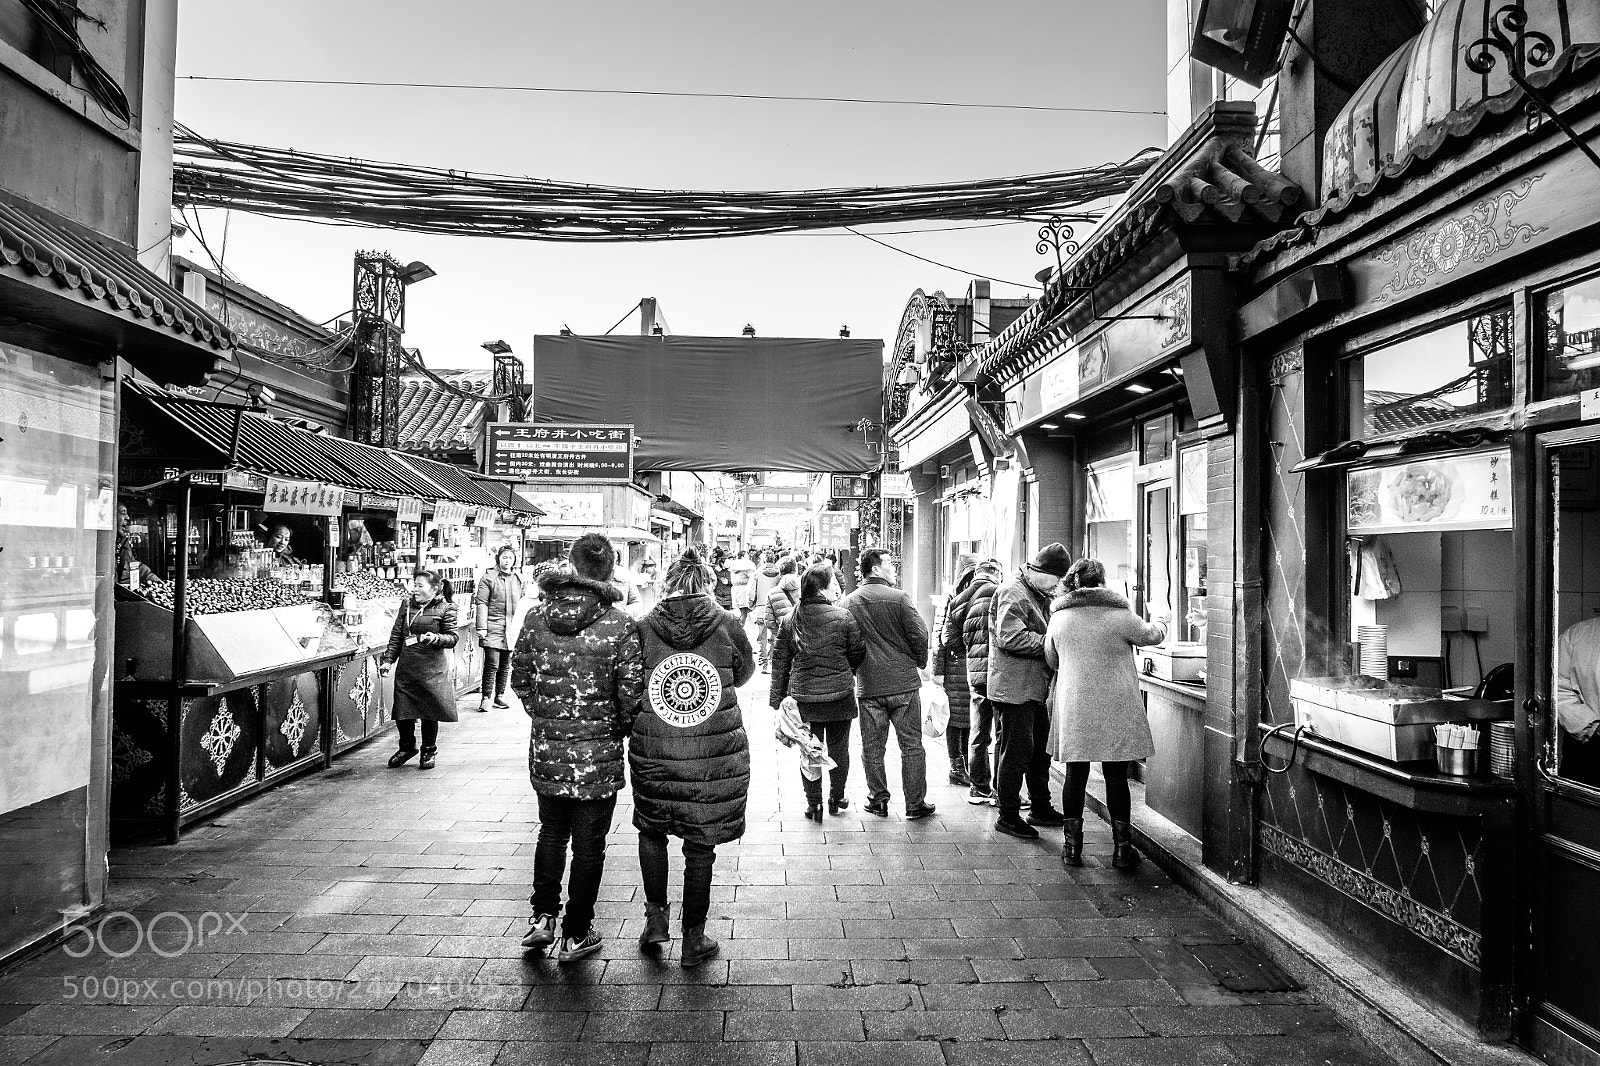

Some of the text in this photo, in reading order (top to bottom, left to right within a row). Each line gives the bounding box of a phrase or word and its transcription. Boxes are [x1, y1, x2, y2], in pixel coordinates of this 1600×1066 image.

[513, 428, 626, 440] 王府井小吃街
